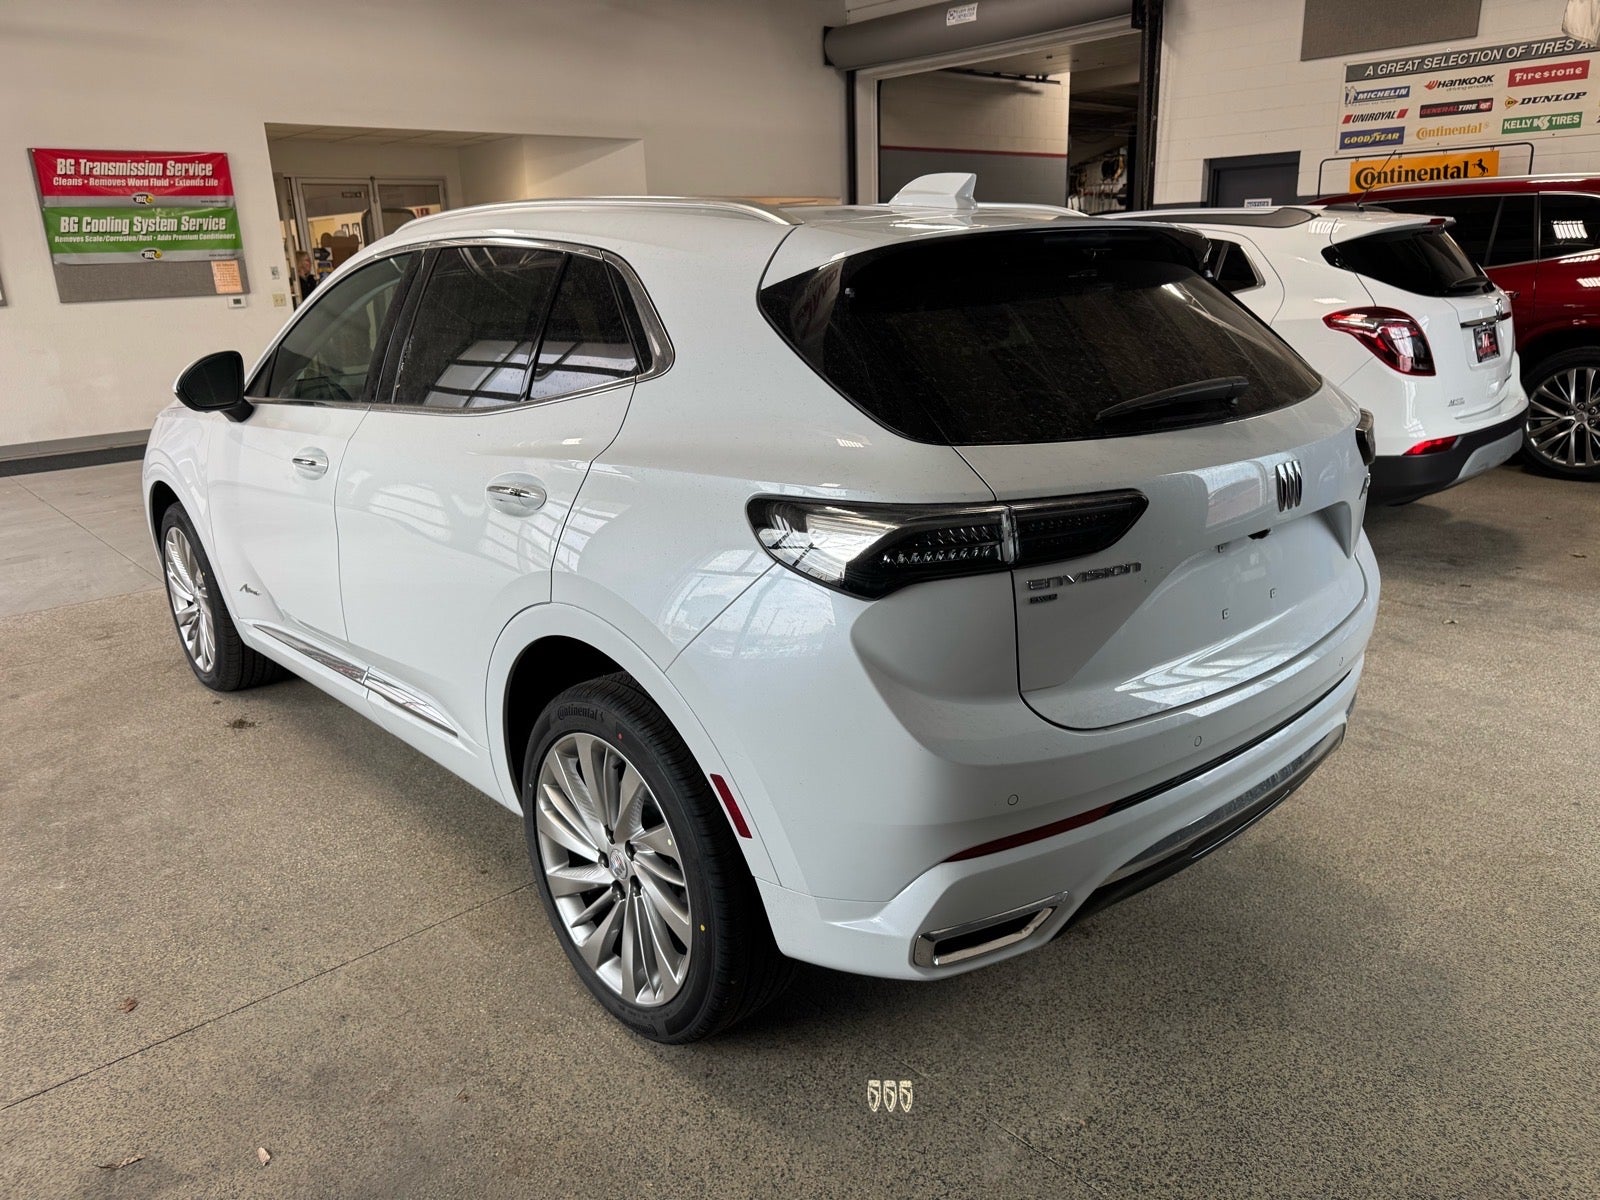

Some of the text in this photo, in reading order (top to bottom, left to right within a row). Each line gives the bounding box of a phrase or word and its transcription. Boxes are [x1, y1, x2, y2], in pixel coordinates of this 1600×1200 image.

[1364, 66, 1375, 77] A
[1377, 60, 1421, 75] GREAT
[1424, 48, 1501, 70] SELECTION
[1505, 45, 1527, 60] OF
[1528, 38, 1575, 56] TIRES
[1514, 67, 1582, 83] Firestone
[1357, 88, 1409, 100] MICHELIN
[1518, 91, 1588, 105] DUNLOP
[1352, 110, 1397, 123] UNIROYAL
[1504, 118, 1533, 130] KELLY
[1551, 114, 1580, 125] TIRES
[1344, 132, 1400, 144] GOODYEAR
[1416, 122, 1482, 140] Continental
[57, 158, 213, 177] BG Transmission Service
[1355, 161, 1469, 190] Continental
[53, 177, 219, 187] Cleans Removes Worn Fluid Extends Life
[60, 215, 226, 236] BG Cooling System Service
[55, 235, 84, 243] Removes
[172, 233, 199, 241] Premium
[199, 232, 236, 241] Conditioners
[557, 704, 598, 720] Continental
